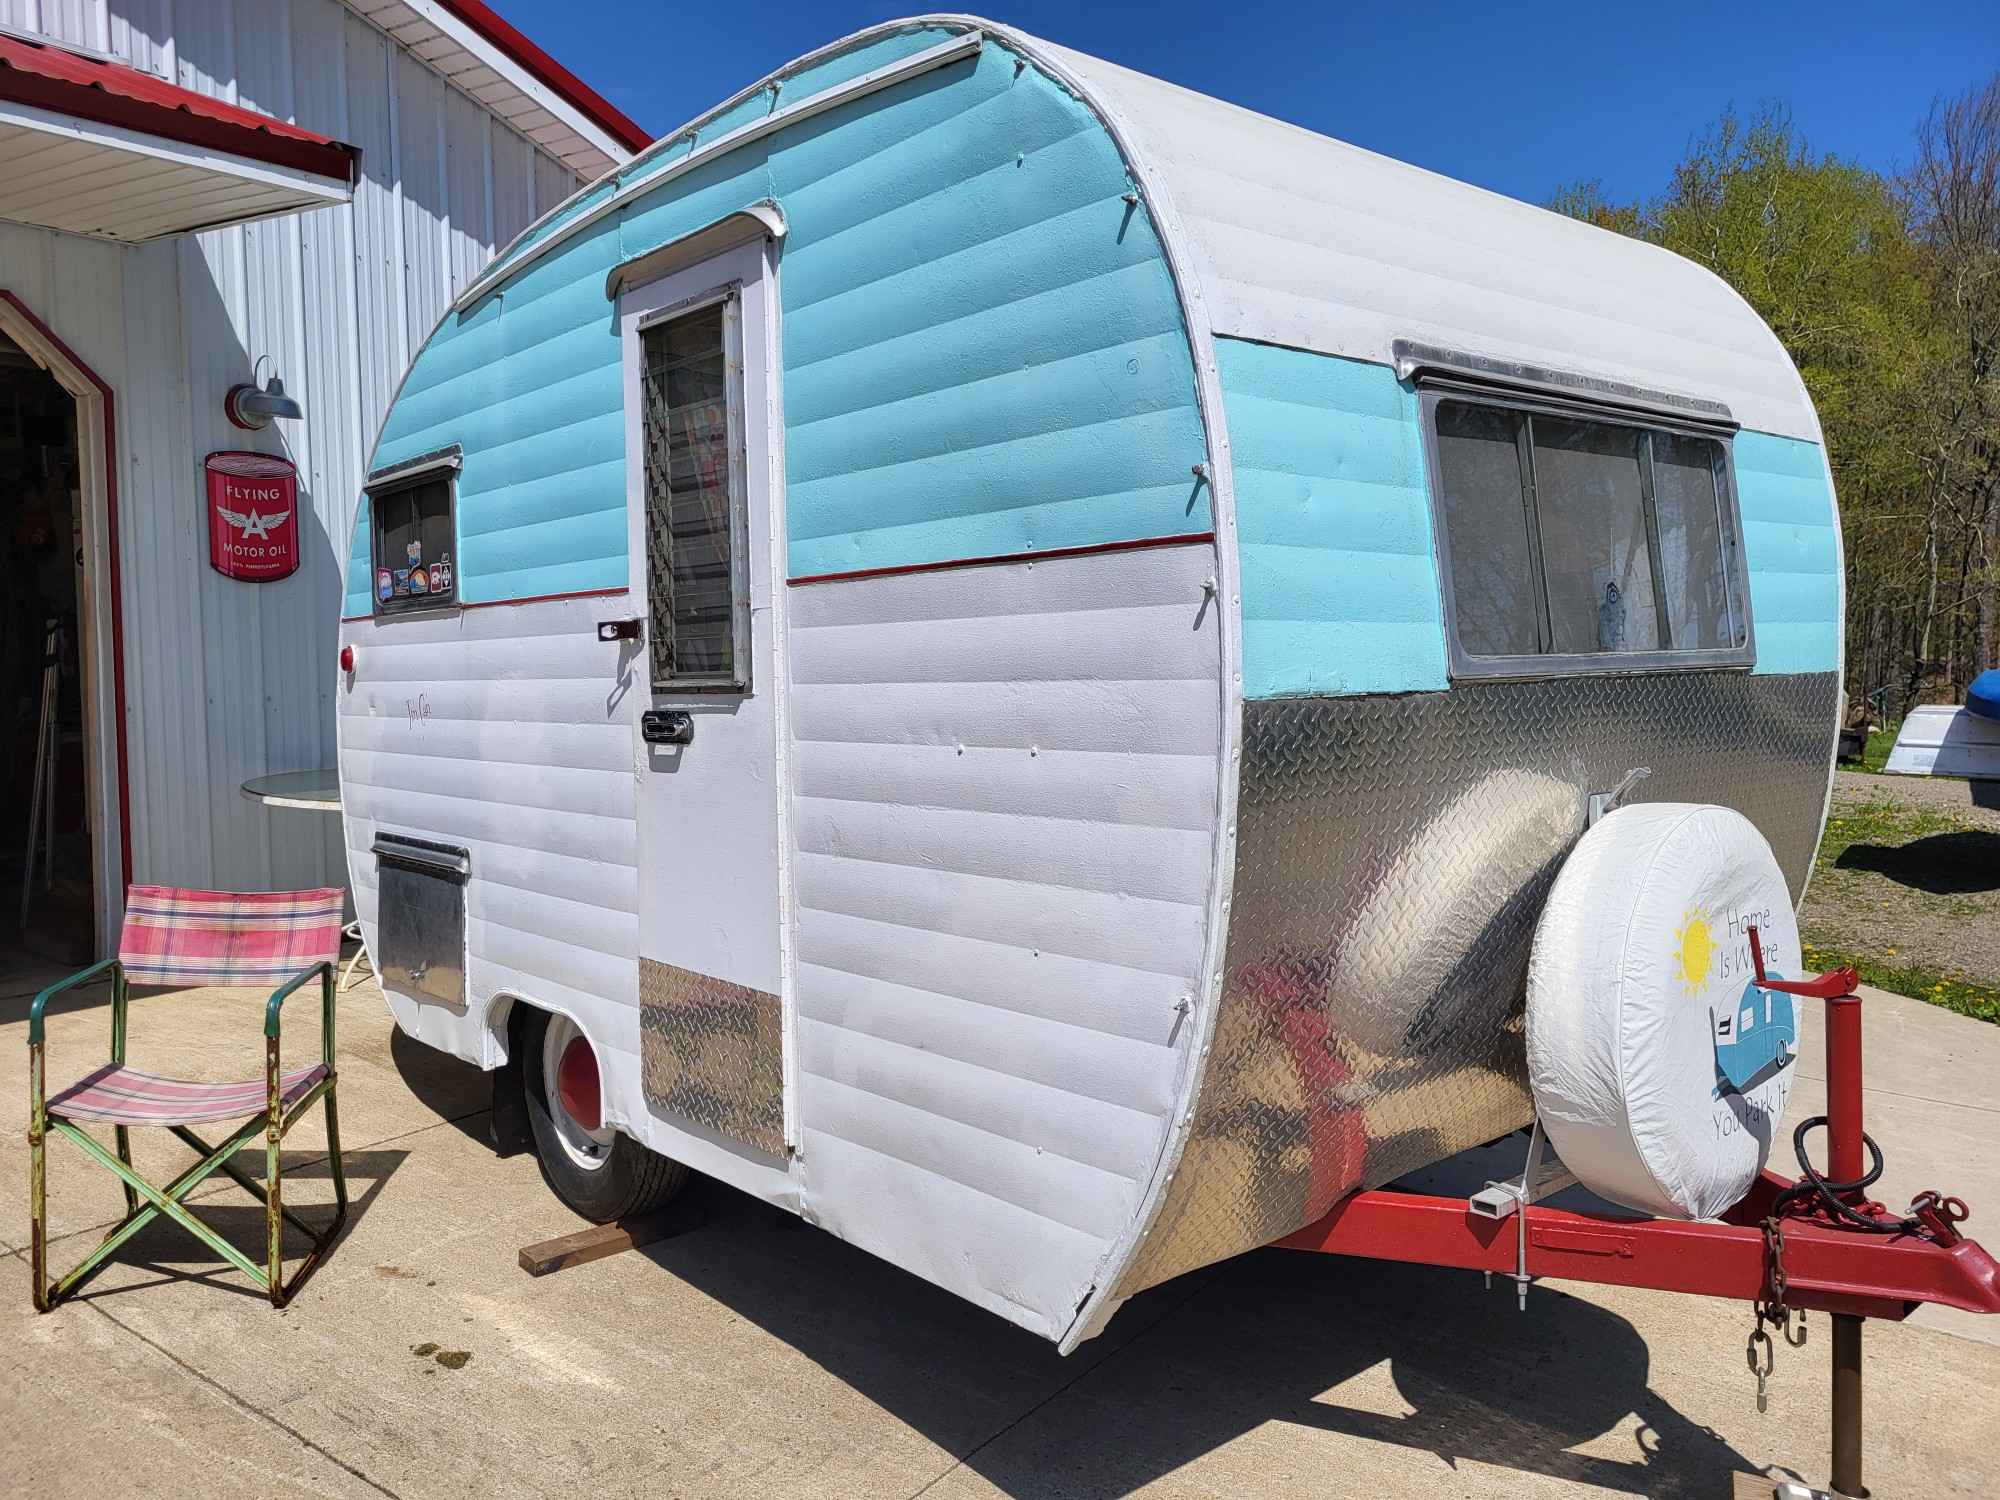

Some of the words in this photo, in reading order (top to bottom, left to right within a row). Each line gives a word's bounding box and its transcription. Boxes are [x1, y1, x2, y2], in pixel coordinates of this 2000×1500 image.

[226, 485, 280, 501] FLYING
[241, 506, 269, 540] A
[223, 542, 265, 558] MOTOR
[268, 543, 287, 557] OIL
[1727, 906, 1770, 938] Home
[1720, 951, 1730, 979] Is
[1735, 943, 1779, 975] Were
[1712, 1110, 1740, 1141] You
[1745, 1085, 1775, 1127] Park
[1778, 1081, 1787, 1111] It
